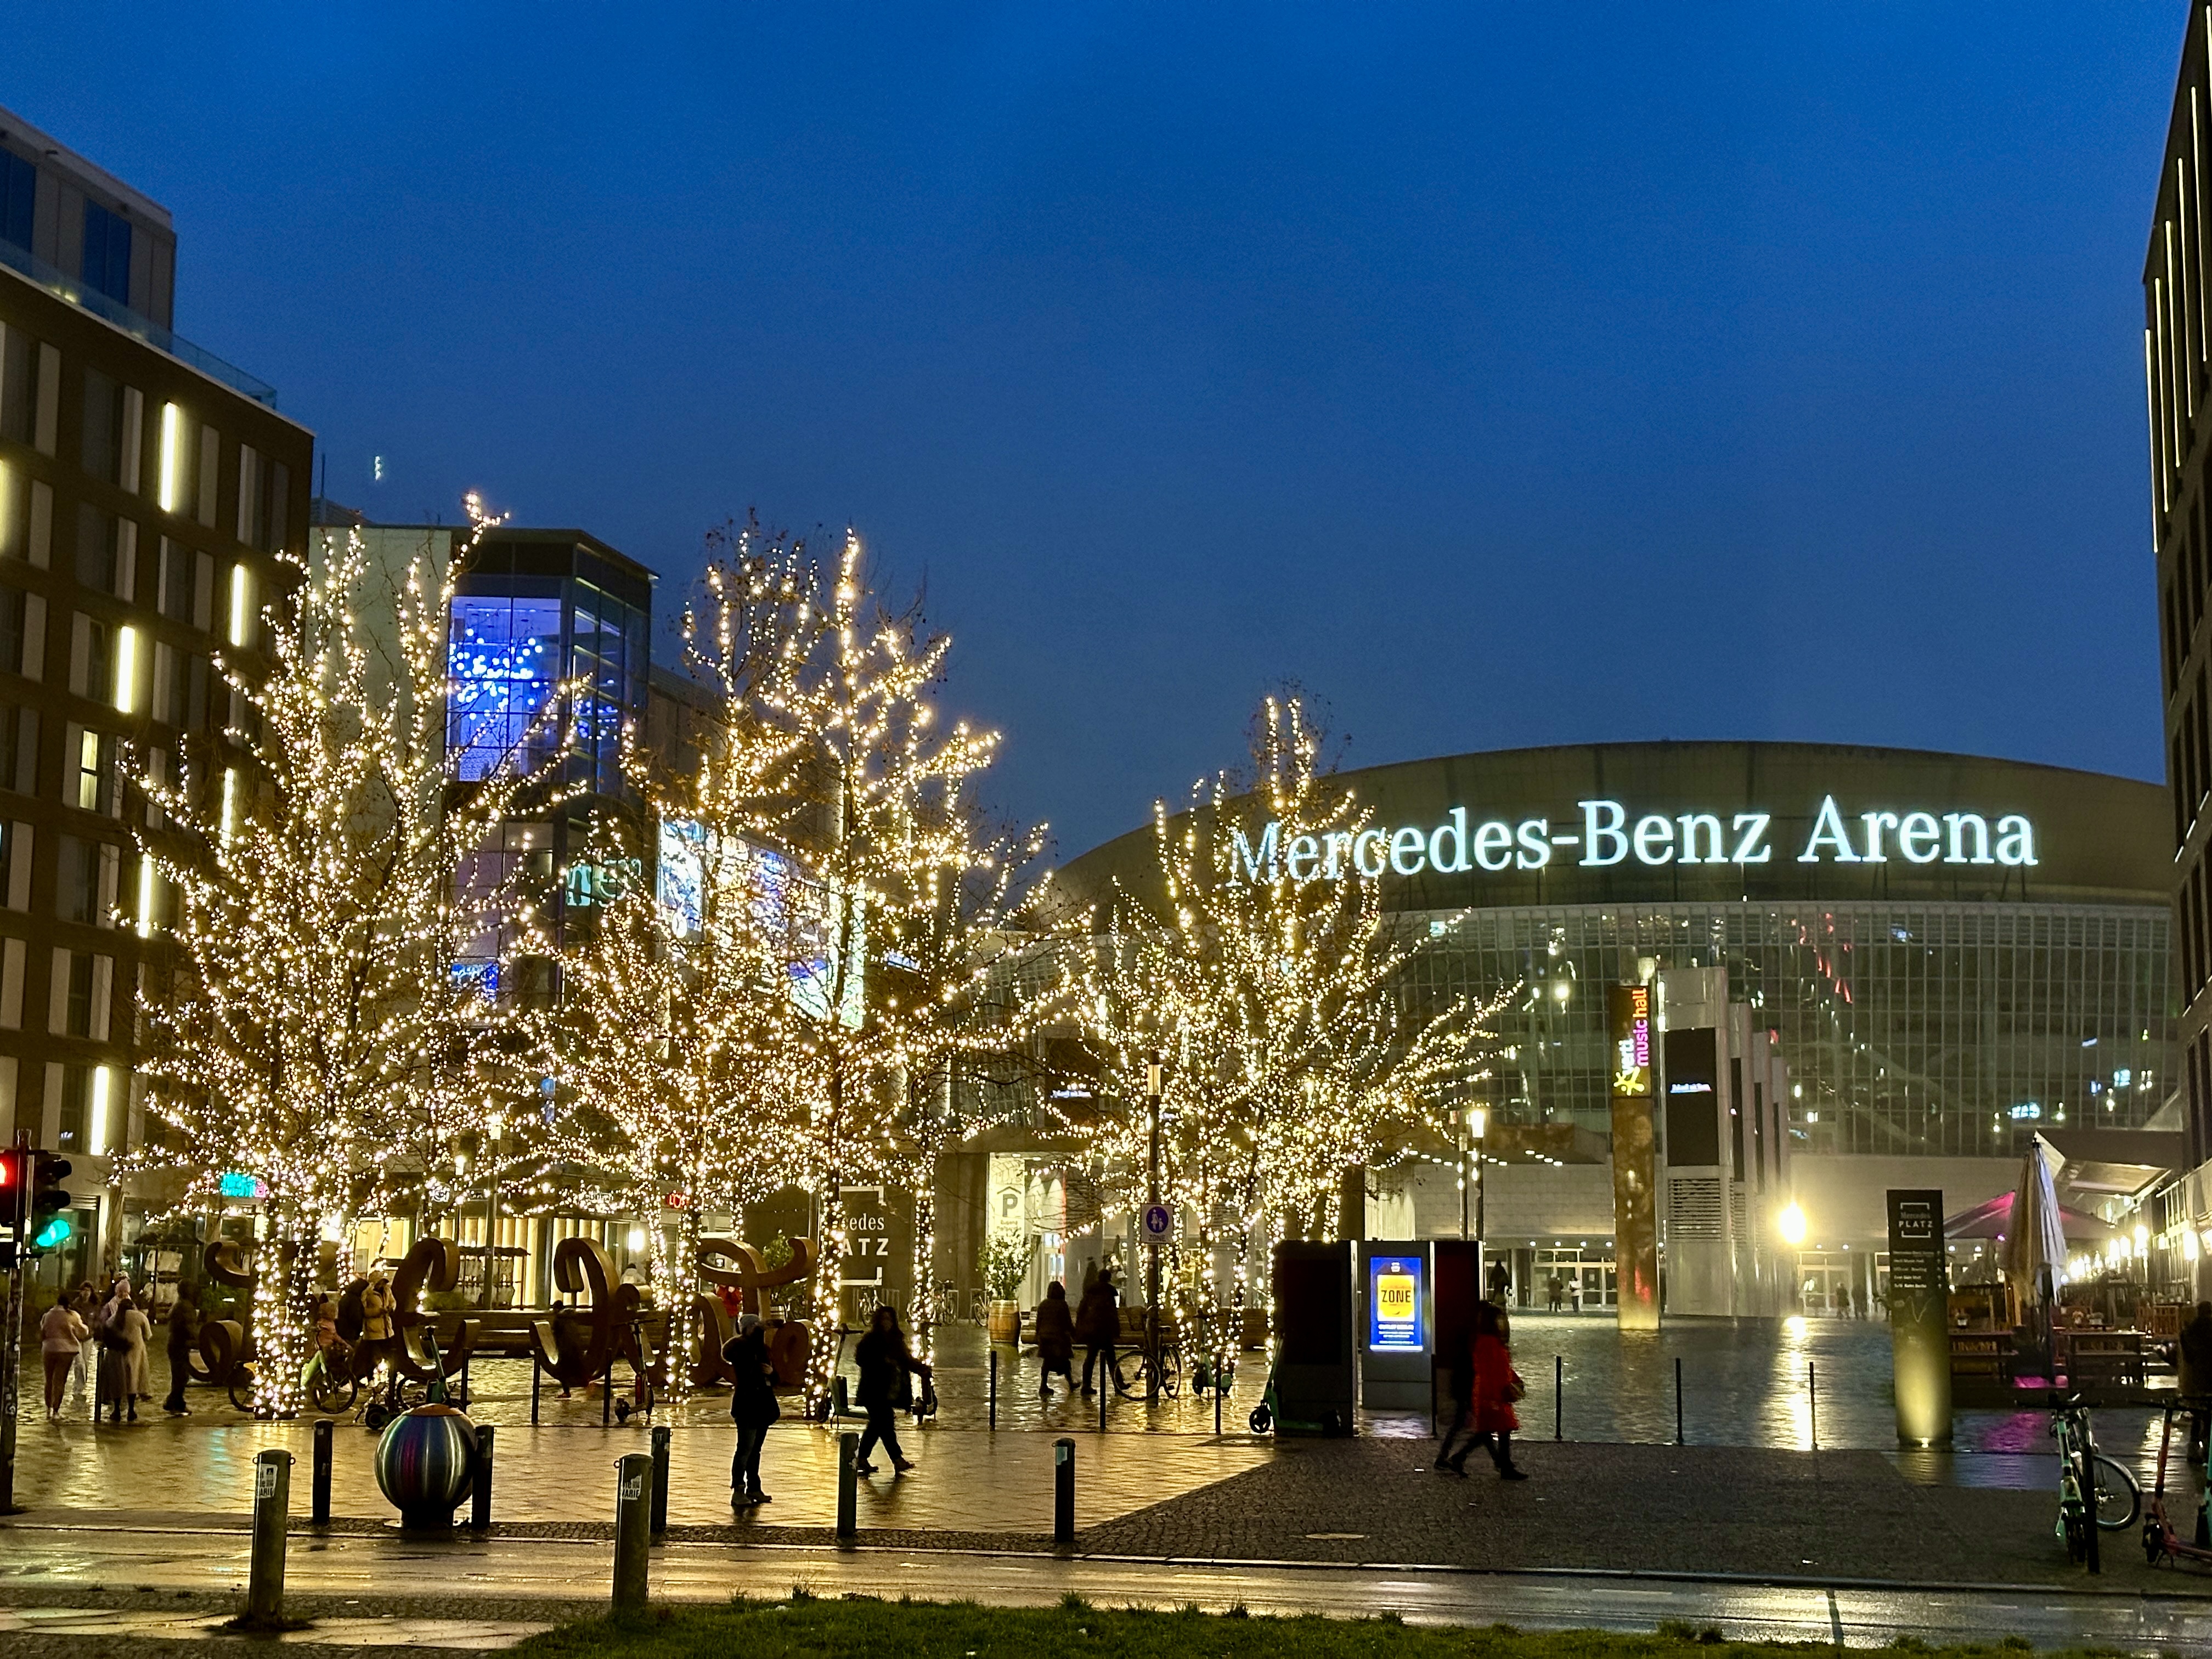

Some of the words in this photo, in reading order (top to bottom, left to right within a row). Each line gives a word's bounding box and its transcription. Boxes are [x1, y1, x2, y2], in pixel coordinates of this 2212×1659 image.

[1226, 800, 1771, 887] Mercedes-Benz
[1797, 794, 2039, 866] Arena
[1632, 988, 1647, 1018] hall
[1633, 1019, 1649, 1066] music
[1618, 1038, 1635, 1075] verti
[1002, 1194, 1018, 1217] P
[840, 1212, 884, 1231] cedes
[840, 1238, 889, 1256] ATZ
[1148, 1234, 1166, 1242] ZONE
[1381, 1290, 1412, 1303] ZONE
